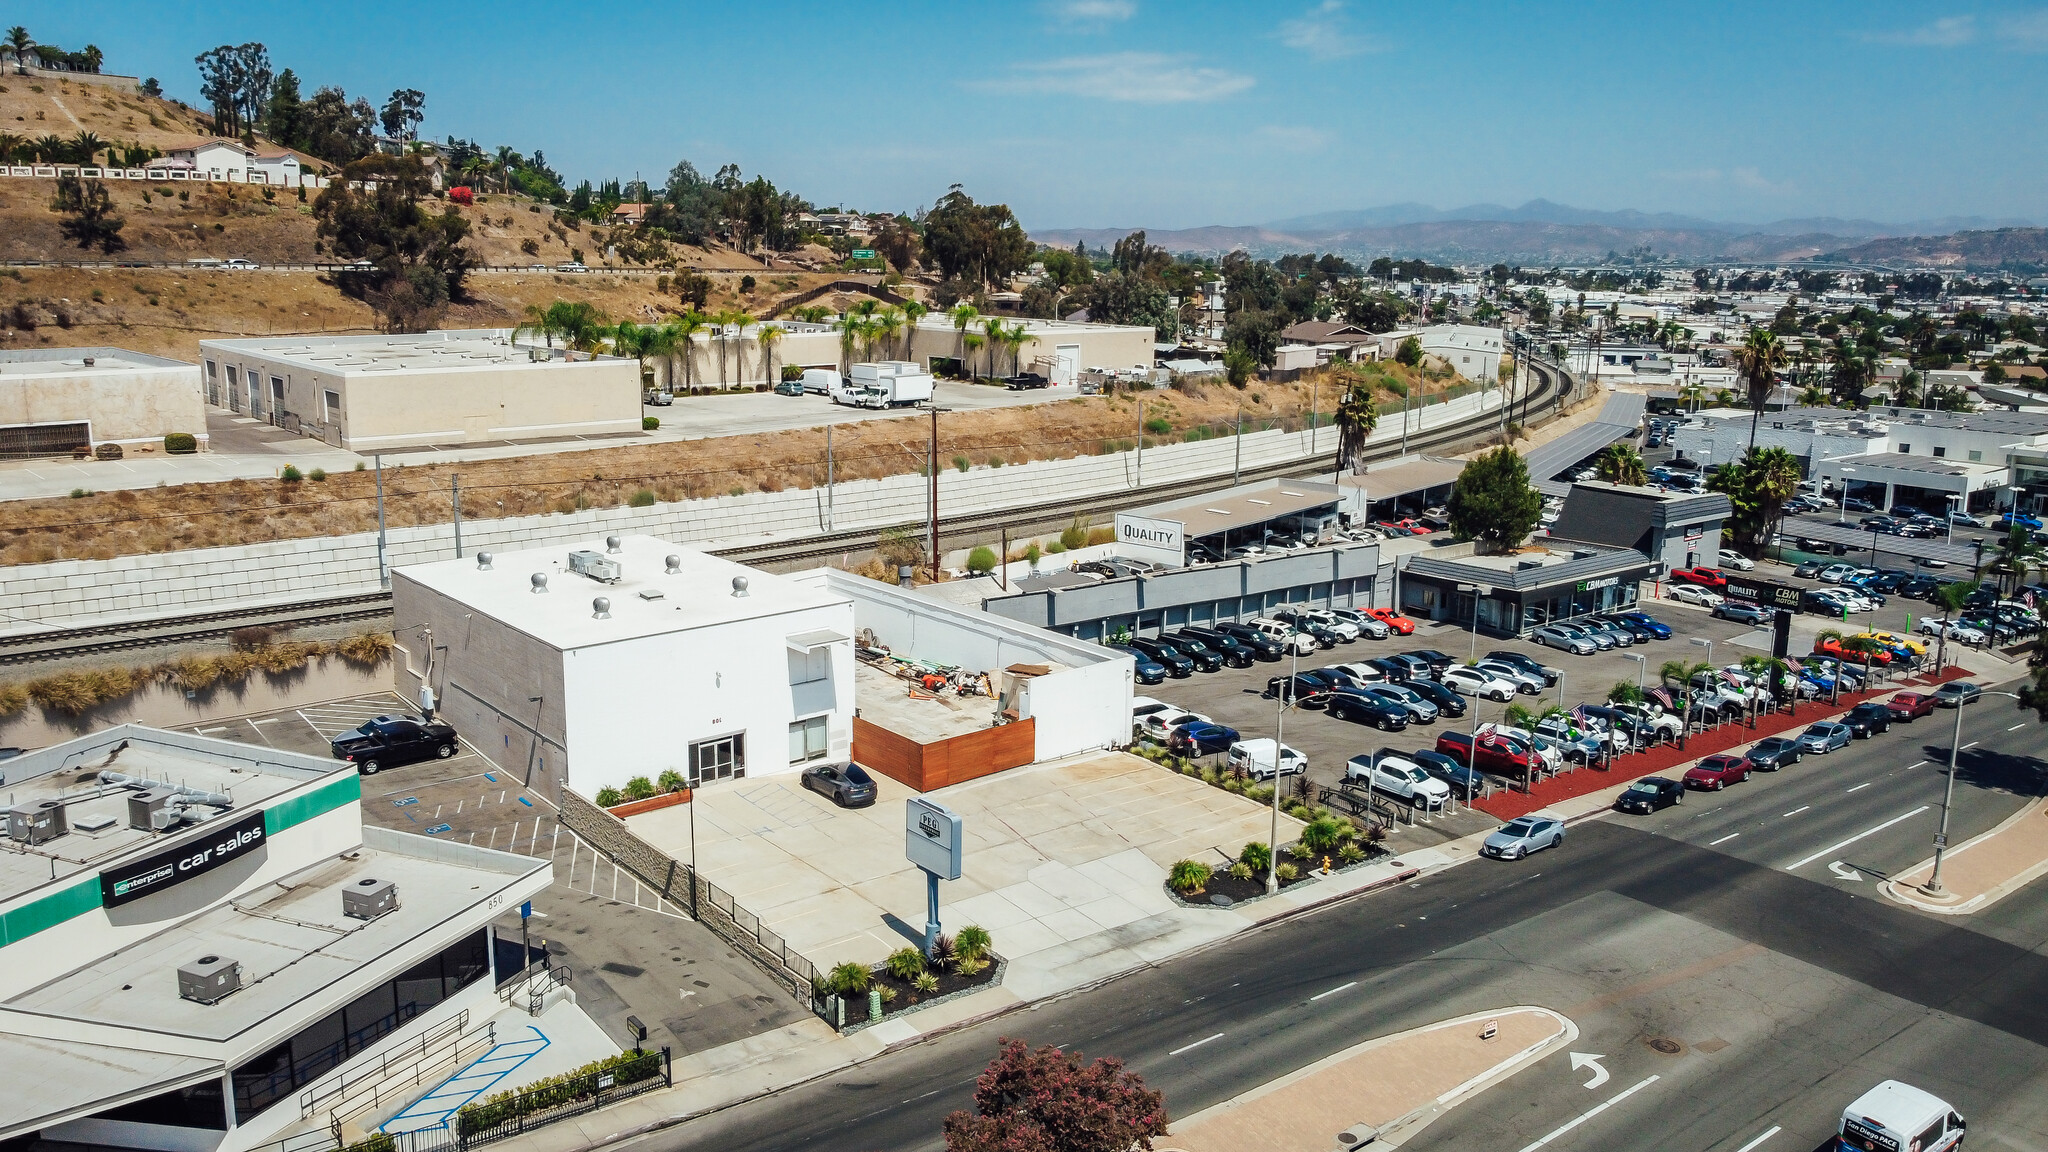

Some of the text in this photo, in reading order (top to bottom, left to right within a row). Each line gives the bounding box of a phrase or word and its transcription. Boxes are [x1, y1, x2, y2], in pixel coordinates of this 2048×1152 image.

[1124, 524, 1173, 543] QUALITY
[1727, 584, 1758, 597] QUALITY
[1775, 588, 1799, 601] CBM
[1774, 597, 1799, 607] MOTORS
[923, 815, 937, 829] PEG
[116, 826, 262, 891] enterprise car sales
[489, 895, 503, 909] 850
[1846, 1120, 1859, 1130] San
[1859, 1126, 1879, 1140] Diego
[1879, 1135, 1898, 1147] PACE
